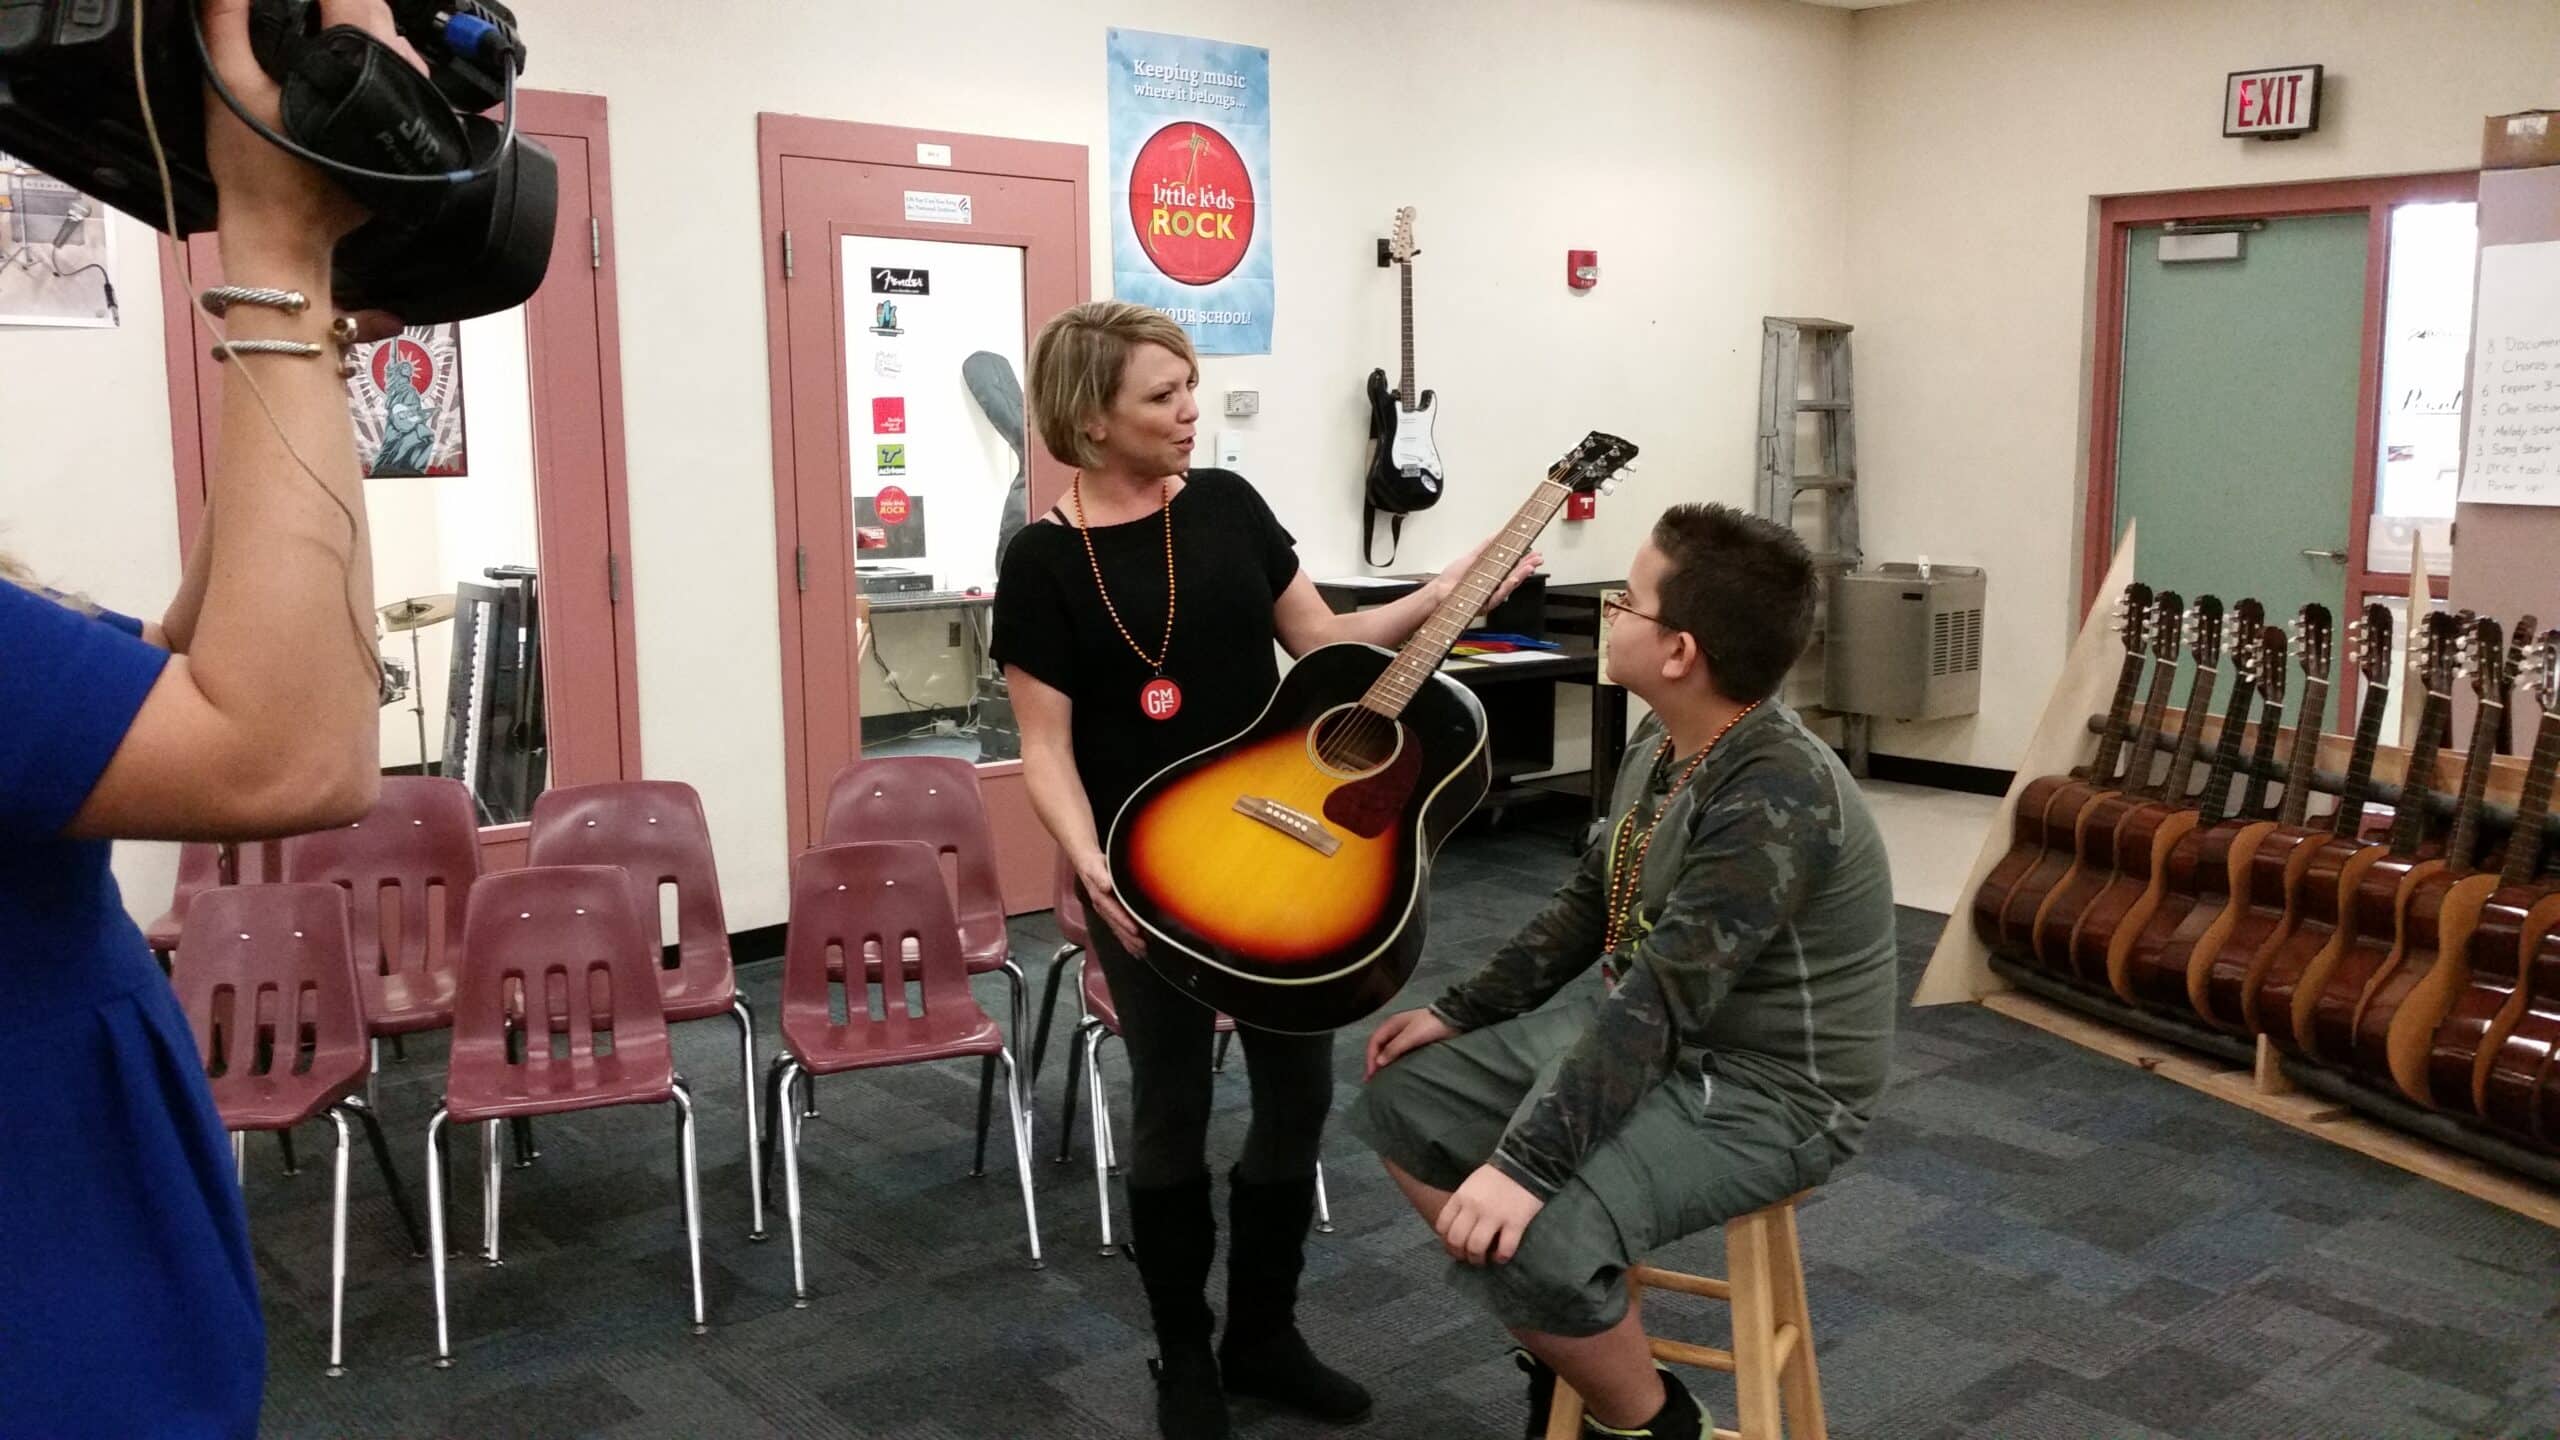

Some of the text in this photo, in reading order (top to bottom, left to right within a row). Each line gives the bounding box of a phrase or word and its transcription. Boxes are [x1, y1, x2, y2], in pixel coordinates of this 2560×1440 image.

[1133, 59, 1247, 89] Keeping music
[1133, 83, 1176, 100] where
[1177, 87, 1188, 101] it
[2238, 75, 2303, 128] EXIT
[1152, 178, 1236, 210] little kids
[1152, 208, 1236, 240] ROCK
[876, 269, 924, 290] Fender
[1197, 309, 1252, 327] SCHOOL!
